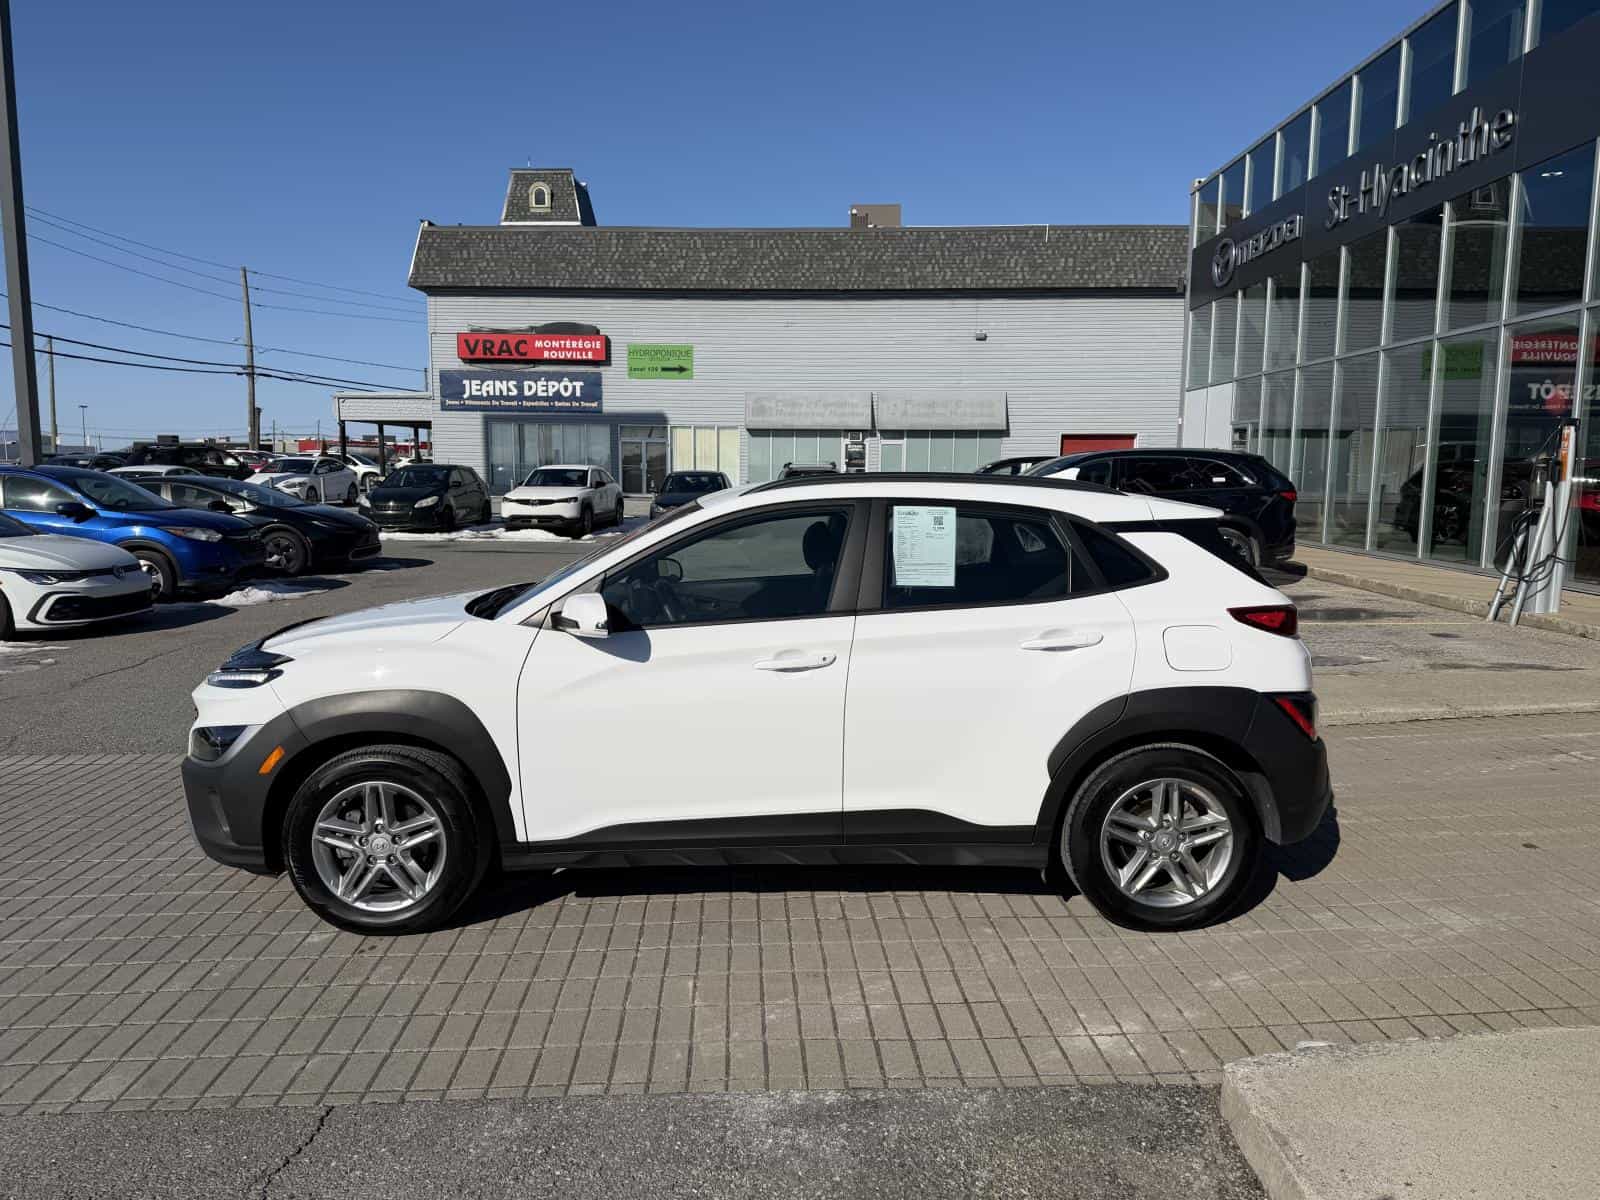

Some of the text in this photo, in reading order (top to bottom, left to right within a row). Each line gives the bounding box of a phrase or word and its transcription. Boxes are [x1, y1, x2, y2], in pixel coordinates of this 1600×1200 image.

[1325, 106, 1516, 231] St-Hyacinthe
[463, 339, 528, 357] VRAC
[534, 338, 601, 349] MONTÉRÉGIE
[543, 350, 593, 360] ROUVILLE
[462, 377, 585, 399] JEANS DÉPÔT
